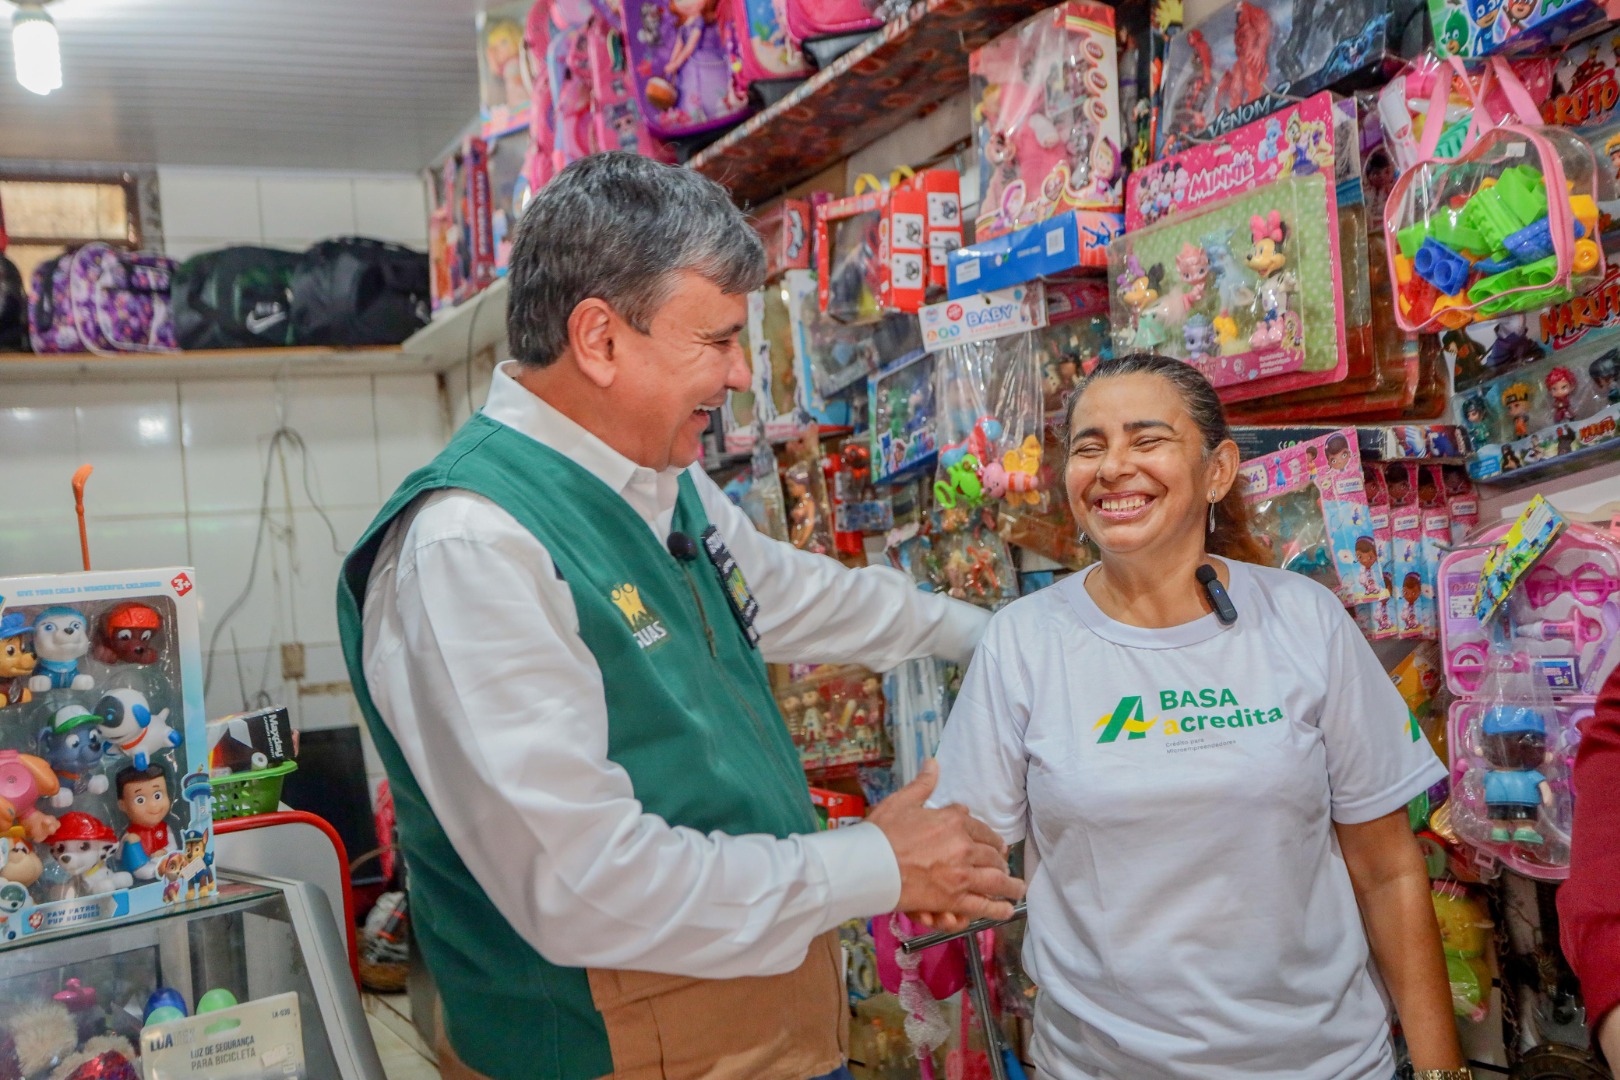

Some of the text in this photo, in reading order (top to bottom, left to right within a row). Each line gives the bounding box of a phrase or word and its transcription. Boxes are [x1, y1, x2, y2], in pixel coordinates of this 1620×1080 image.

[1544, 78, 1619, 127] ARUTO
[1208, 94, 1271, 137] VENOM
[1188, 159, 1255, 202] MINNIE
[966, 303, 1013, 327] BABY
[1539, 284, 1620, 345] NARUT
[174, 578, 192, 592] 3+
[1159, 688, 1239, 711] BASA
[1163, 706, 1284, 735] acredita
[269, 713, 284, 758] Maxday
[1166, 739, 1237, 754] Microempreendedores
[1190, 737, 1205, 747] para
[47, 903, 101, 918] PAW PATROL
[47, 917, 63, 925] PUP
[190, 1035, 255, 1059] LUZ DE SEGURANÇA
[191, 1047, 257, 1071] PARA BICICLETA
